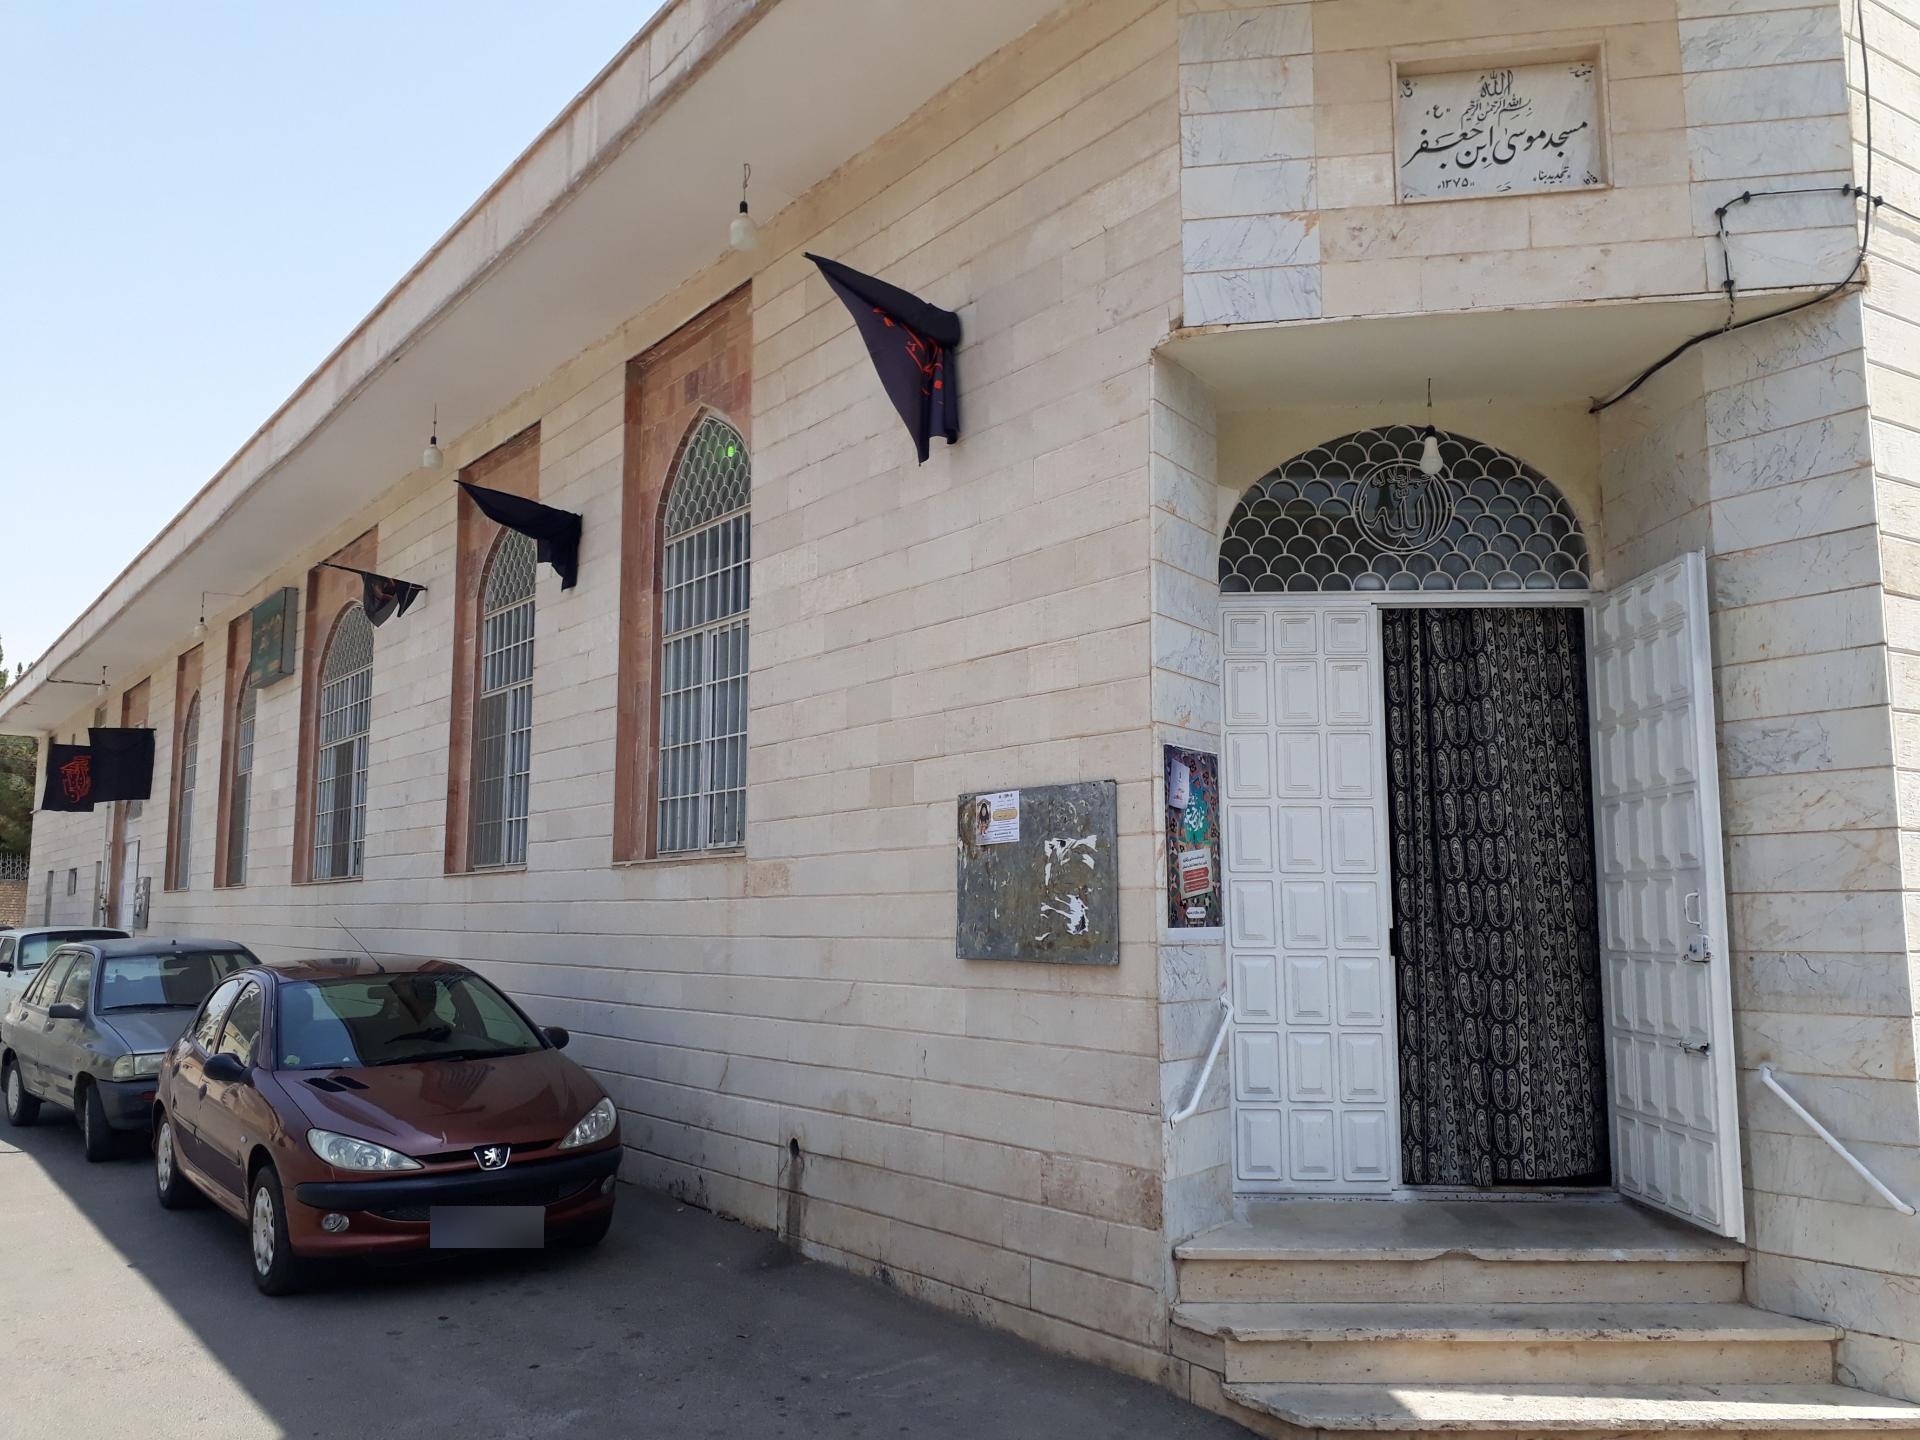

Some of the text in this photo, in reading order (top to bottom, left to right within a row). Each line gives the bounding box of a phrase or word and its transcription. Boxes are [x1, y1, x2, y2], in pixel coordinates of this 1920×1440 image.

[1480, 69, 1514, 98] الله
[1508, 93, 1522, 107] الله
[1401, 128, 1484, 169] جعفر
[1455, 125, 1493, 169] ابن
[1542, 121, 1588, 158] مسجد
